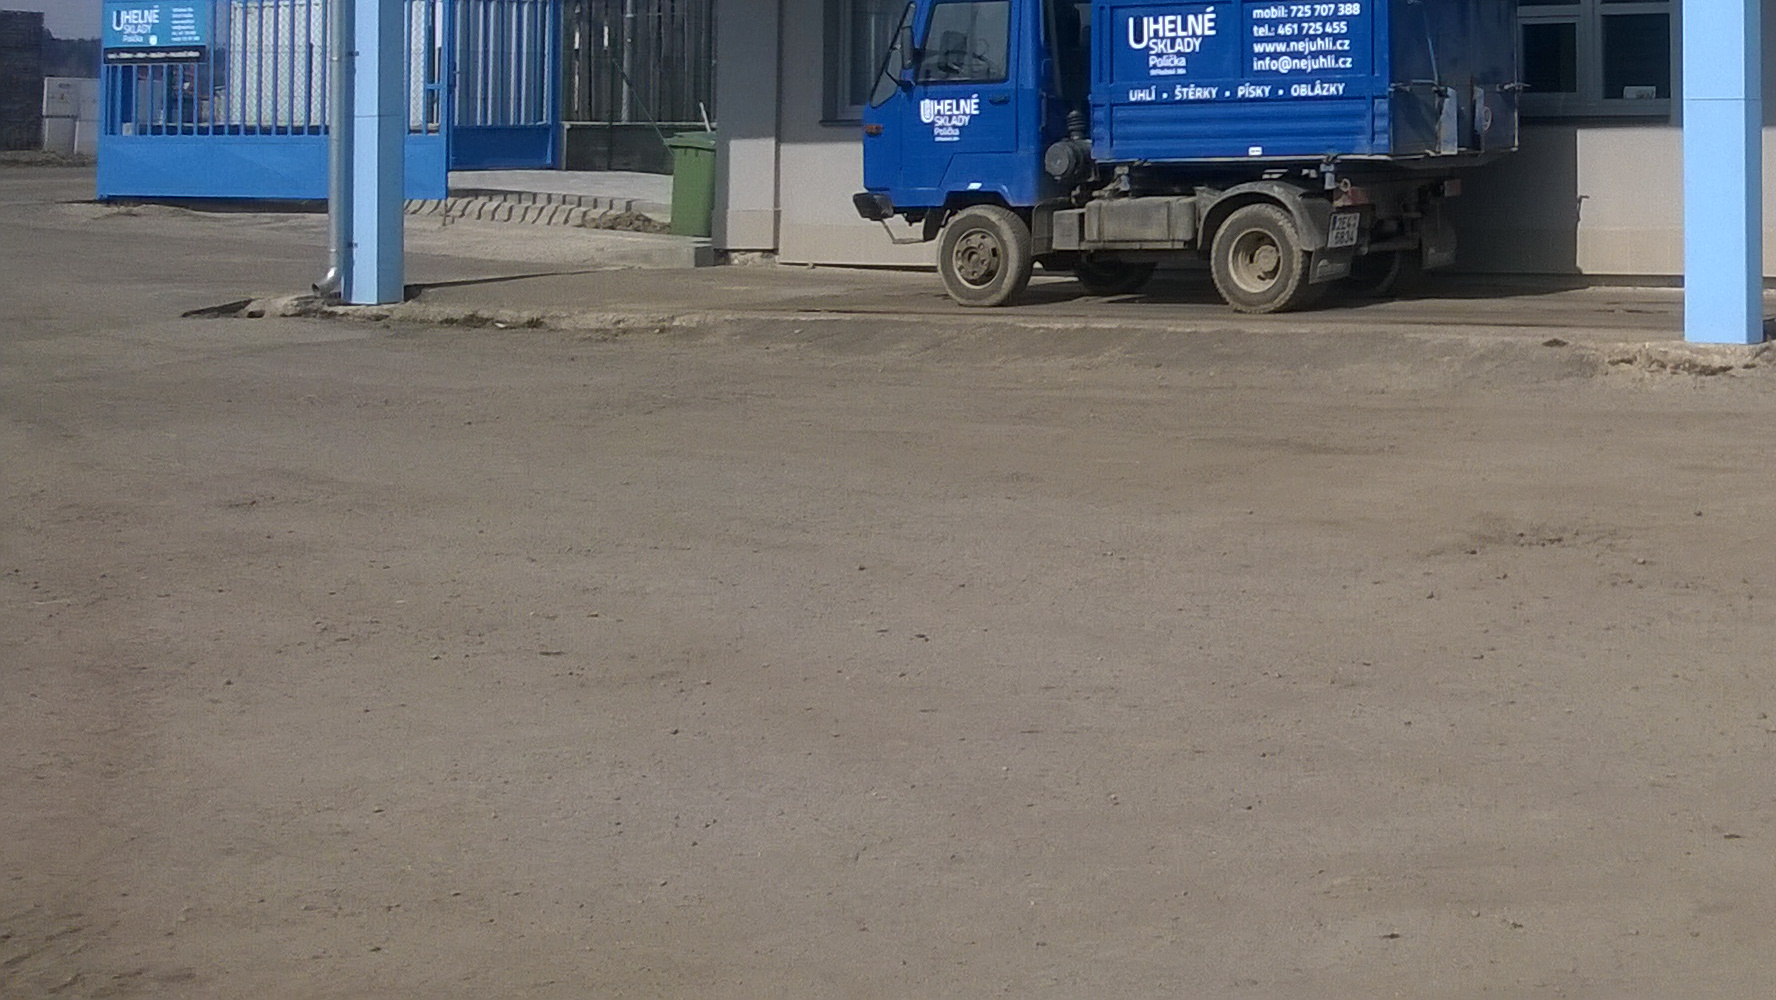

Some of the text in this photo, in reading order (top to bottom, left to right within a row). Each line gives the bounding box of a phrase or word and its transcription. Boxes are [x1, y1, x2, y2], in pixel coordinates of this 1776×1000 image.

[112, 4, 159, 31] UHELNÉ
[1252, 2, 1361, 19] mobil: 725 707 388
[1128, 5, 1217, 49] UHELNÉ
[1252, 20, 1348, 37] tel.: 461 725 455
[1148, 36, 1203, 55] SKLADY
[1252, 36, 1351, 55] www.nejuhli.cz
[1148, 54, 1187, 68] Polička
[1252, 54, 1353, 74] info@nejuhli.cz
[1128, 79, 1346, 102] UHLÍ ŠTĚRKY PÍSKY OBLÁZKY
[920, 93, 980, 124] UHELNÉ
[934, 115, 971, 127] SKLADY
